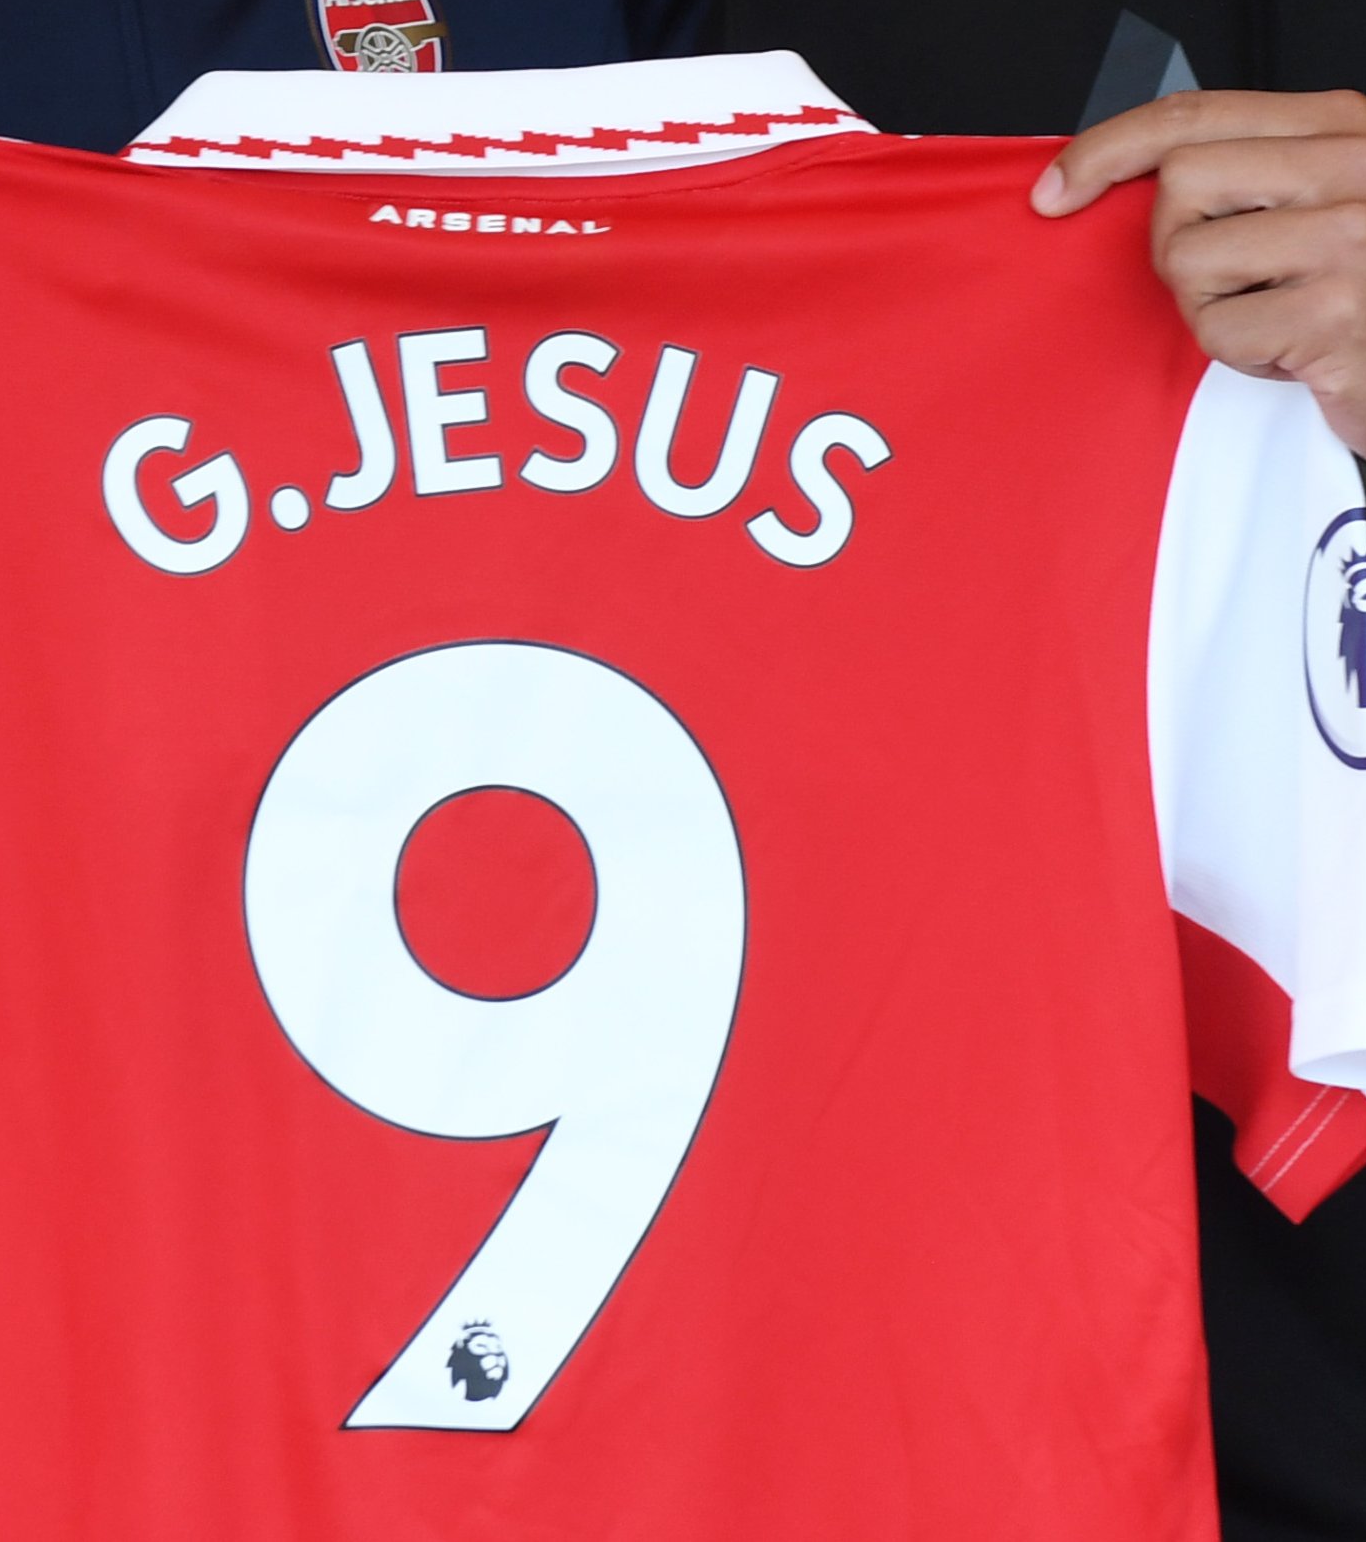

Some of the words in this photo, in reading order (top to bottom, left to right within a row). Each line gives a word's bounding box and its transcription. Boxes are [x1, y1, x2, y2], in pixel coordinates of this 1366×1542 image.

[369, 205, 612, 234] ARSENAL
[101, 326, 893, 576] G.JESUS
[242, 638, 747, 1433] 9
